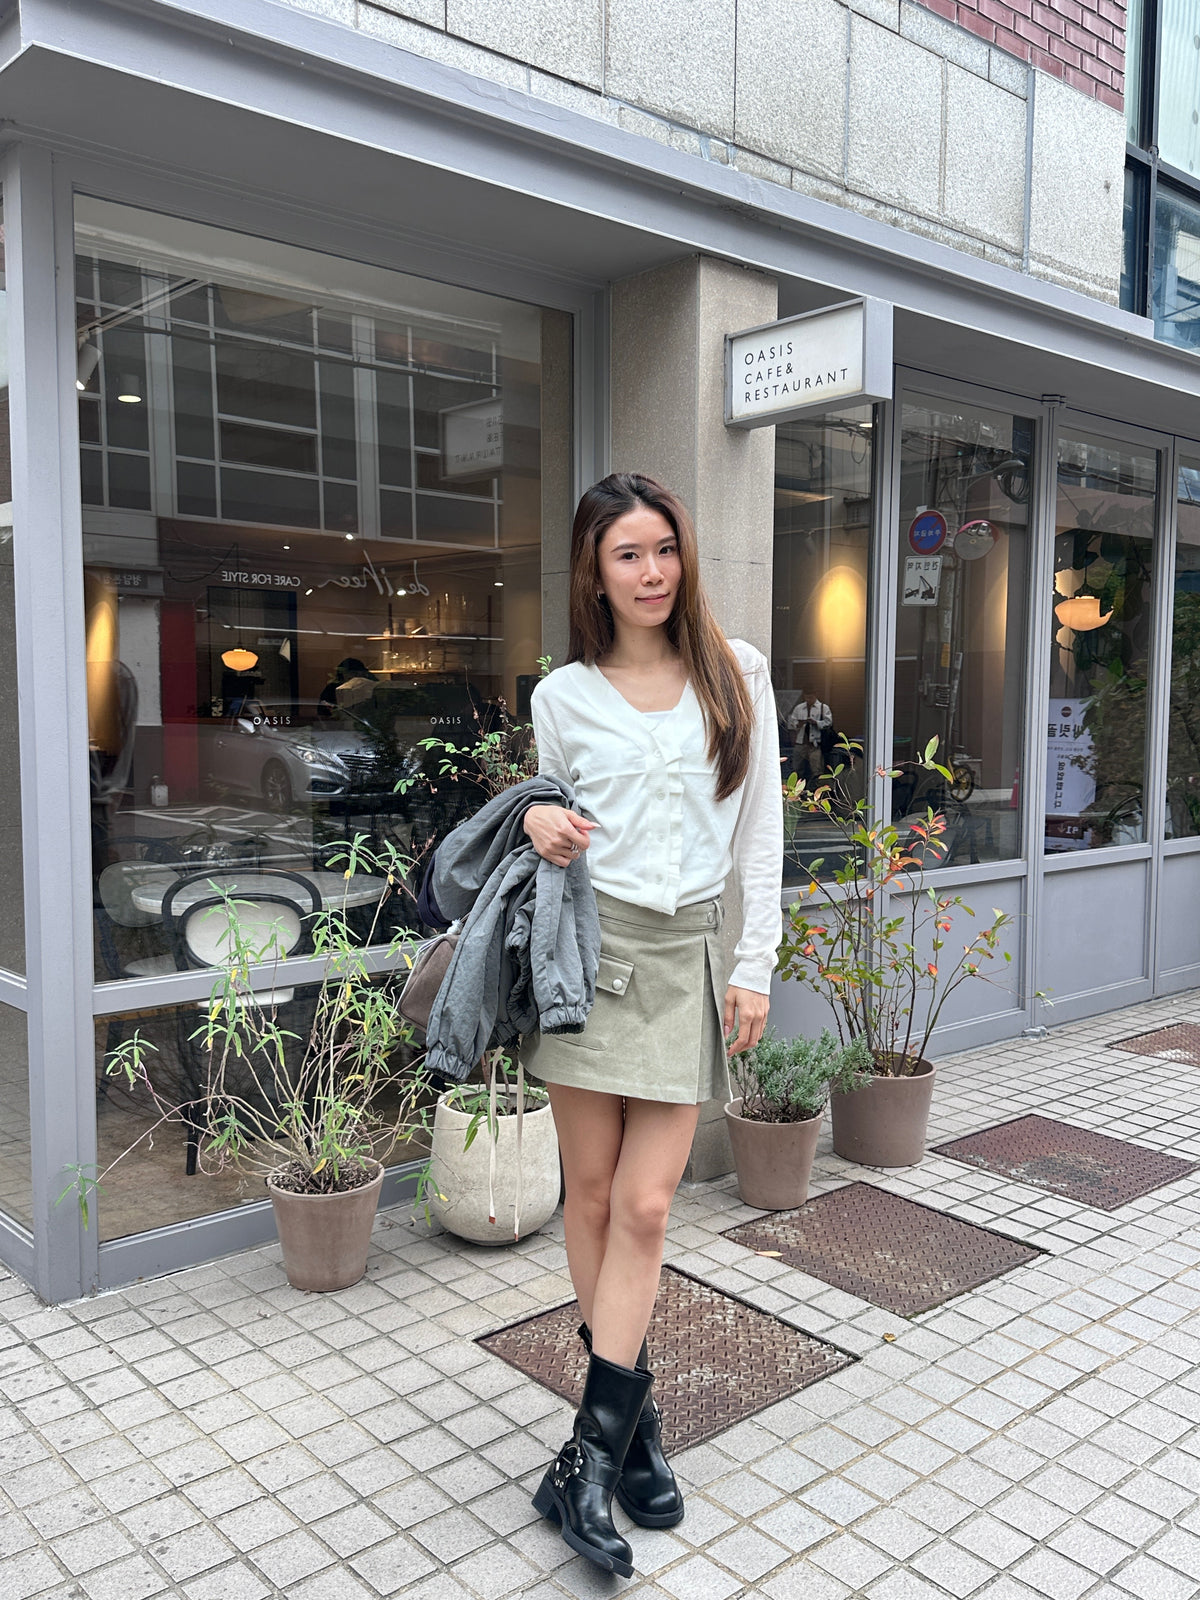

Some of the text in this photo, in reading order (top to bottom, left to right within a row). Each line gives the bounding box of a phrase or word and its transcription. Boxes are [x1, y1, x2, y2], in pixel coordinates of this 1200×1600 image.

[745, 342, 794, 366] OASIS
[745, 363, 794, 385] CAFE&
[745, 368, 848, 403] RESTAURANT
[253, 716, 291, 726] OASIS
[430, 716, 462, 725] OASIS
